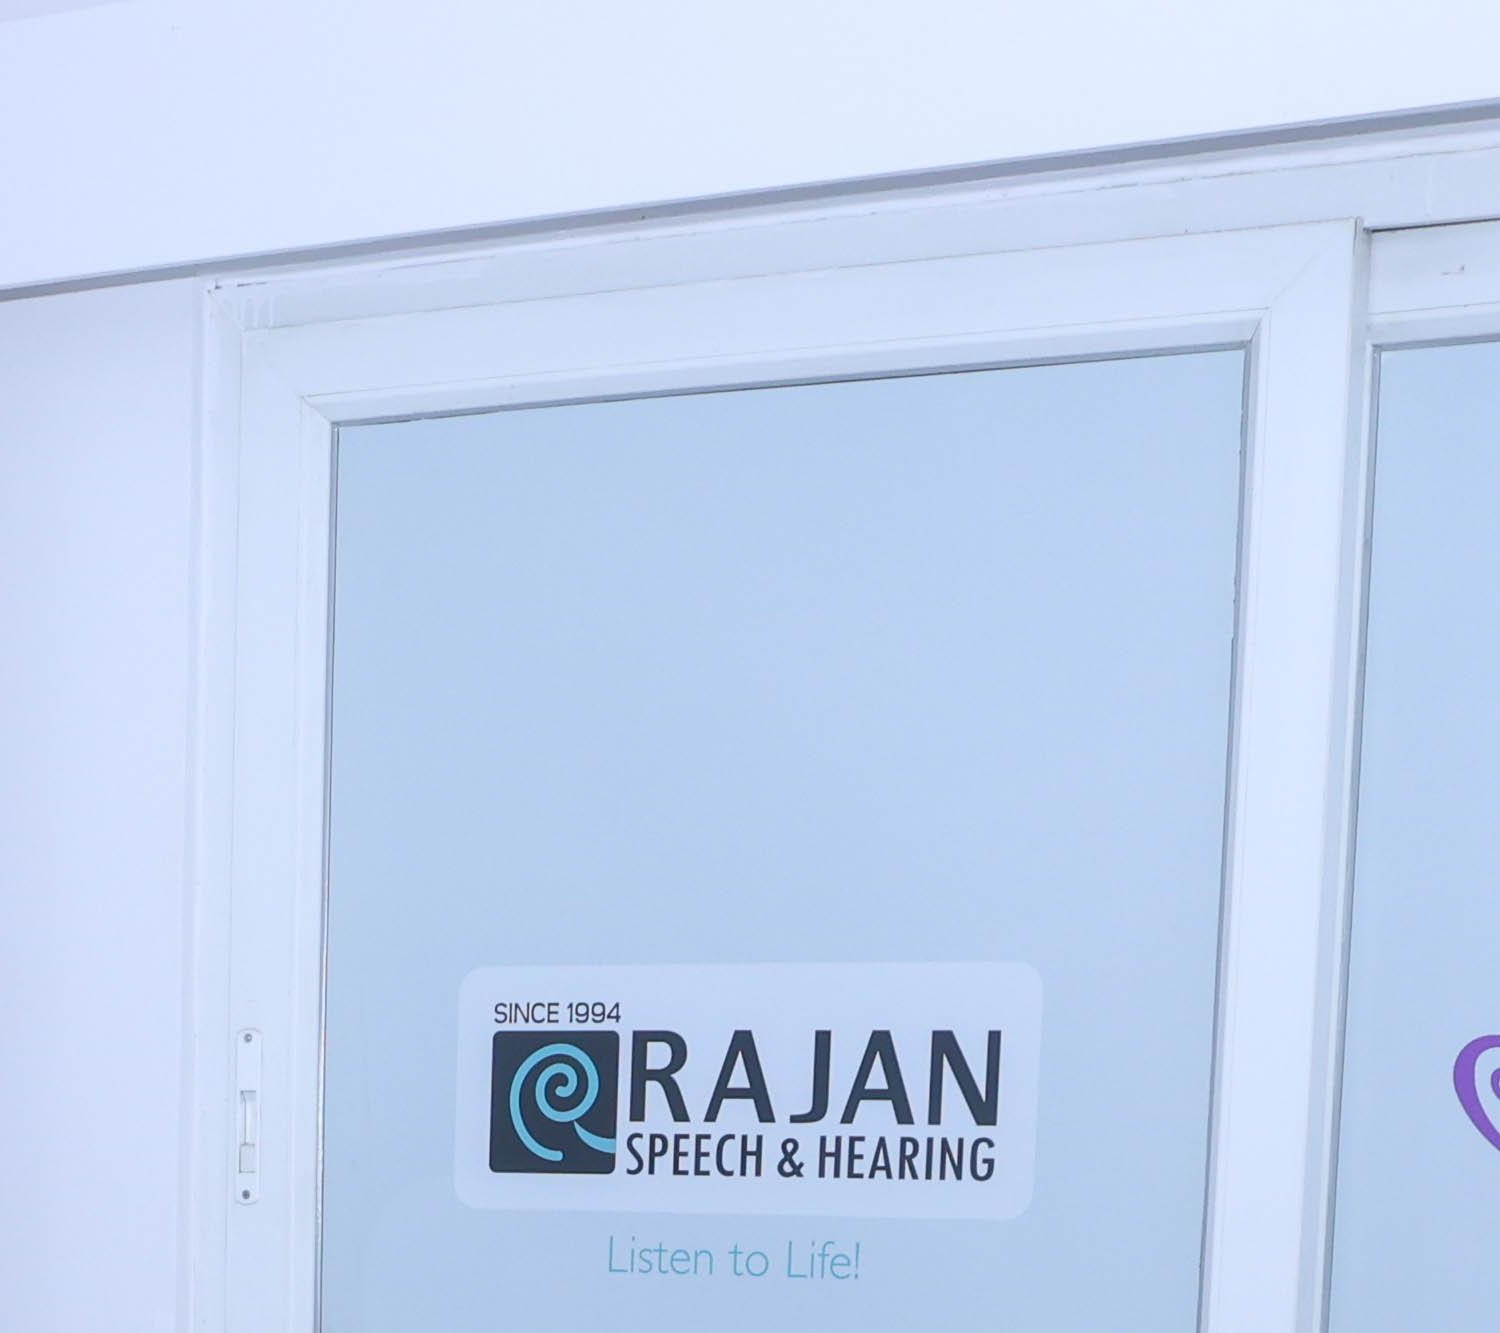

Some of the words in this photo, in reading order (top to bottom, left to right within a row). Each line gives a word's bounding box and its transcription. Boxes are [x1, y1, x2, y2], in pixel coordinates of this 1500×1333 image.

[493, 1001, 560, 1025] SINCE
[566, 1001, 622, 1024] 1994
[628, 1029, 1002, 1127] RAJAN
[626, 1132, 764, 1178] SPEECH
[776, 1137, 805, 1179] &
[817, 1135, 996, 1182] HEARING
[608, 1235, 714, 1276] Listen
[727, 1242, 770, 1278] to
[786, 1239, 861, 1280] Life!
